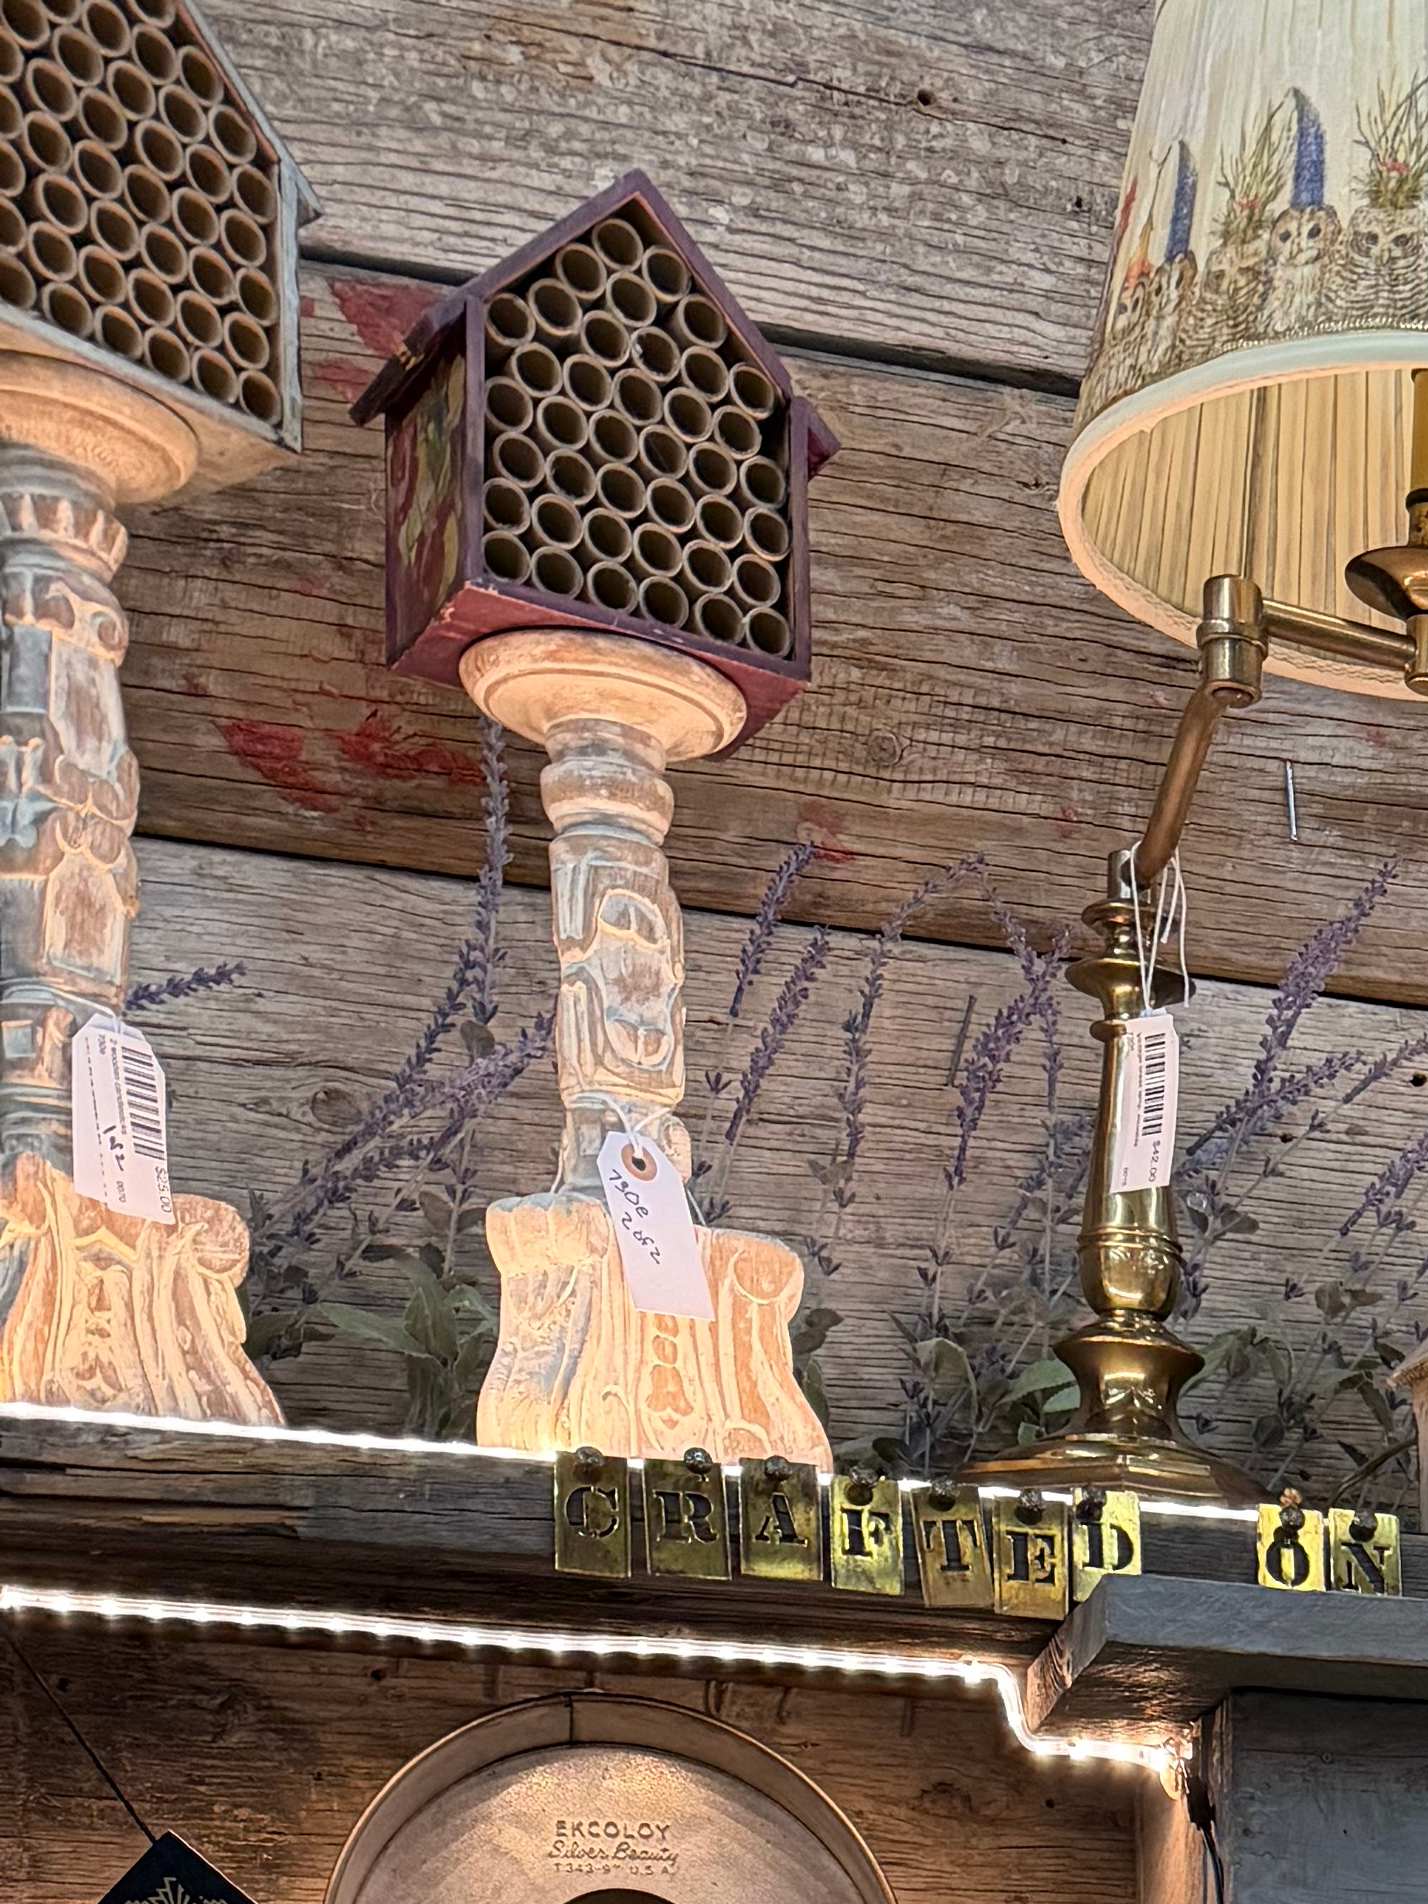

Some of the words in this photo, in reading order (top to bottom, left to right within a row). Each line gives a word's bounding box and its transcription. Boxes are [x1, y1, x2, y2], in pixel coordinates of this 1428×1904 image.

[564, 1485, 1137, 1585] CRAFTED
[1266, 1534, 1388, 1594] ON
[555, 1820, 670, 1840] EKCOLOY
[548, 1840, 609, 1859] Silver
[611, 1841, 679, 1866] Beauty
